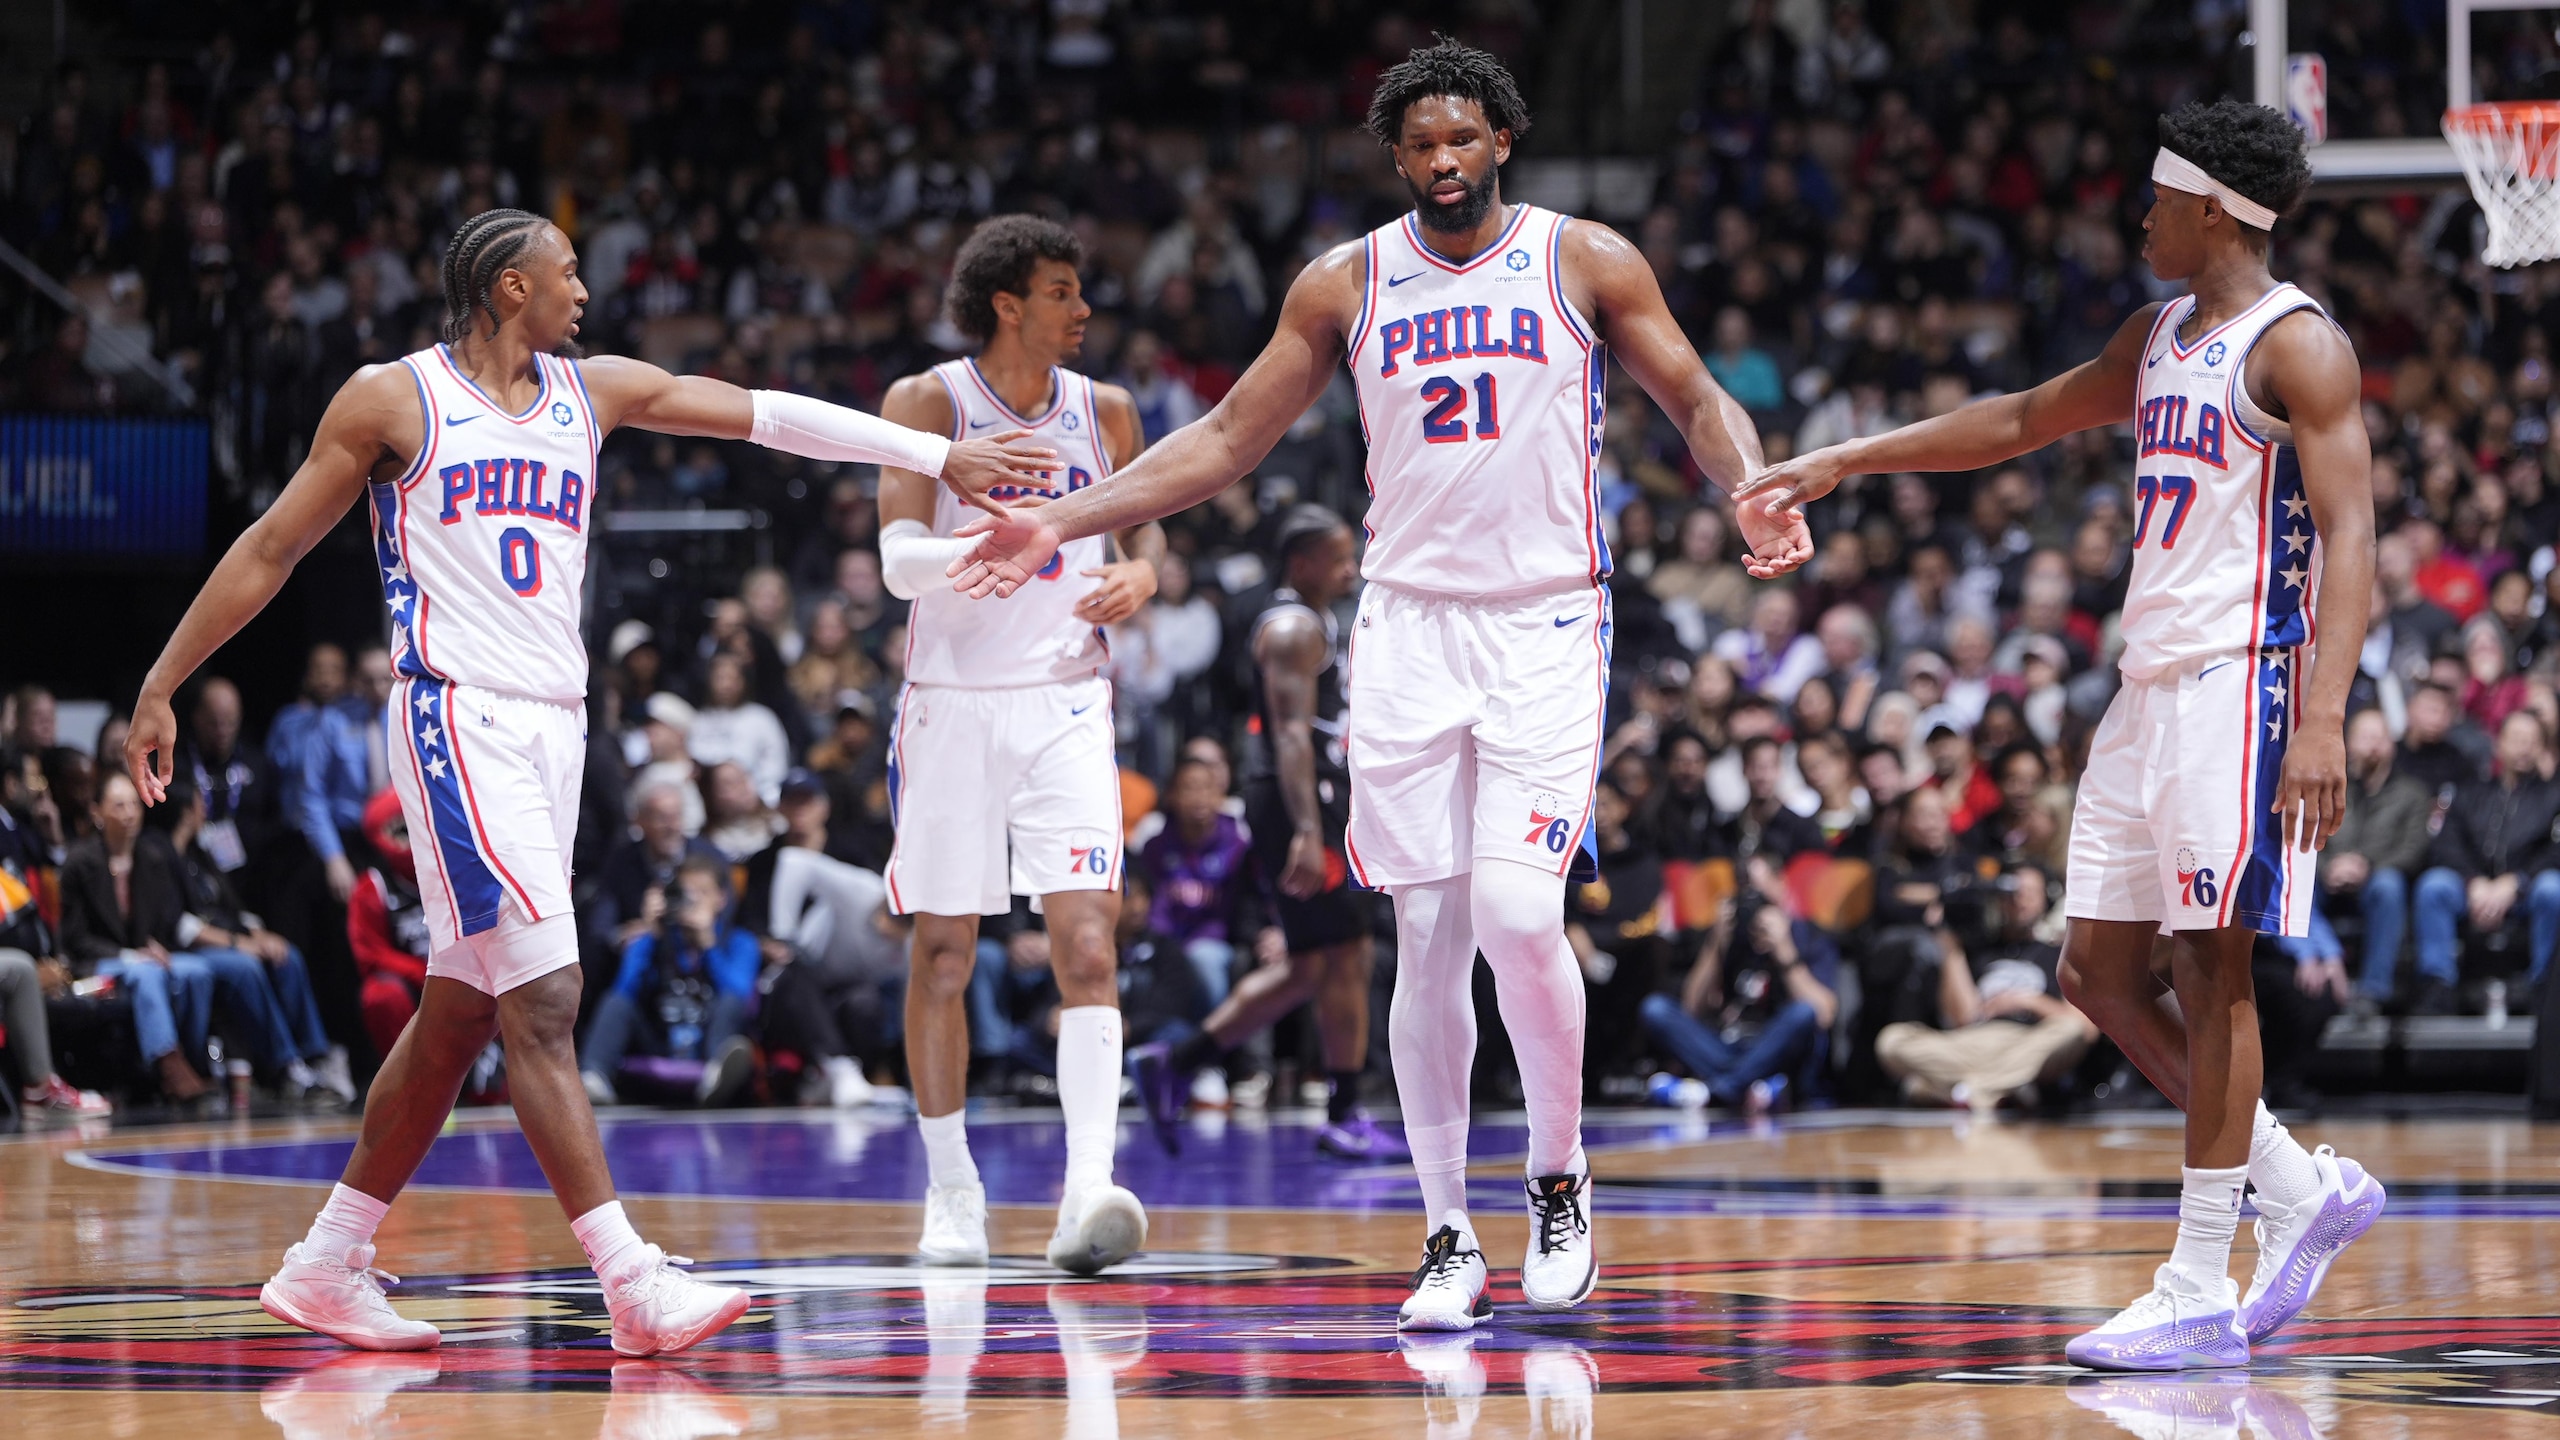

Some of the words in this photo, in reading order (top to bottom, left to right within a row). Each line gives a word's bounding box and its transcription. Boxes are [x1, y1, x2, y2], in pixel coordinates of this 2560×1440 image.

[1494, 275, 1542, 284] crypto.com
[1380, 305, 1549, 379] PHILA
[2190, 370, 2226, 381] crypto.com
[1420, 372, 1500, 444] 21
[2138, 395, 2229, 471] HILA
[439, 458, 585, 534] PHILA
[2133, 475, 2197, 550] 77
[498, 527, 543, 598] 0
[1070, 846, 1108, 875] 76
[1524, 809, 1570, 854] 76
[2177, 867, 2218, 908] 76
